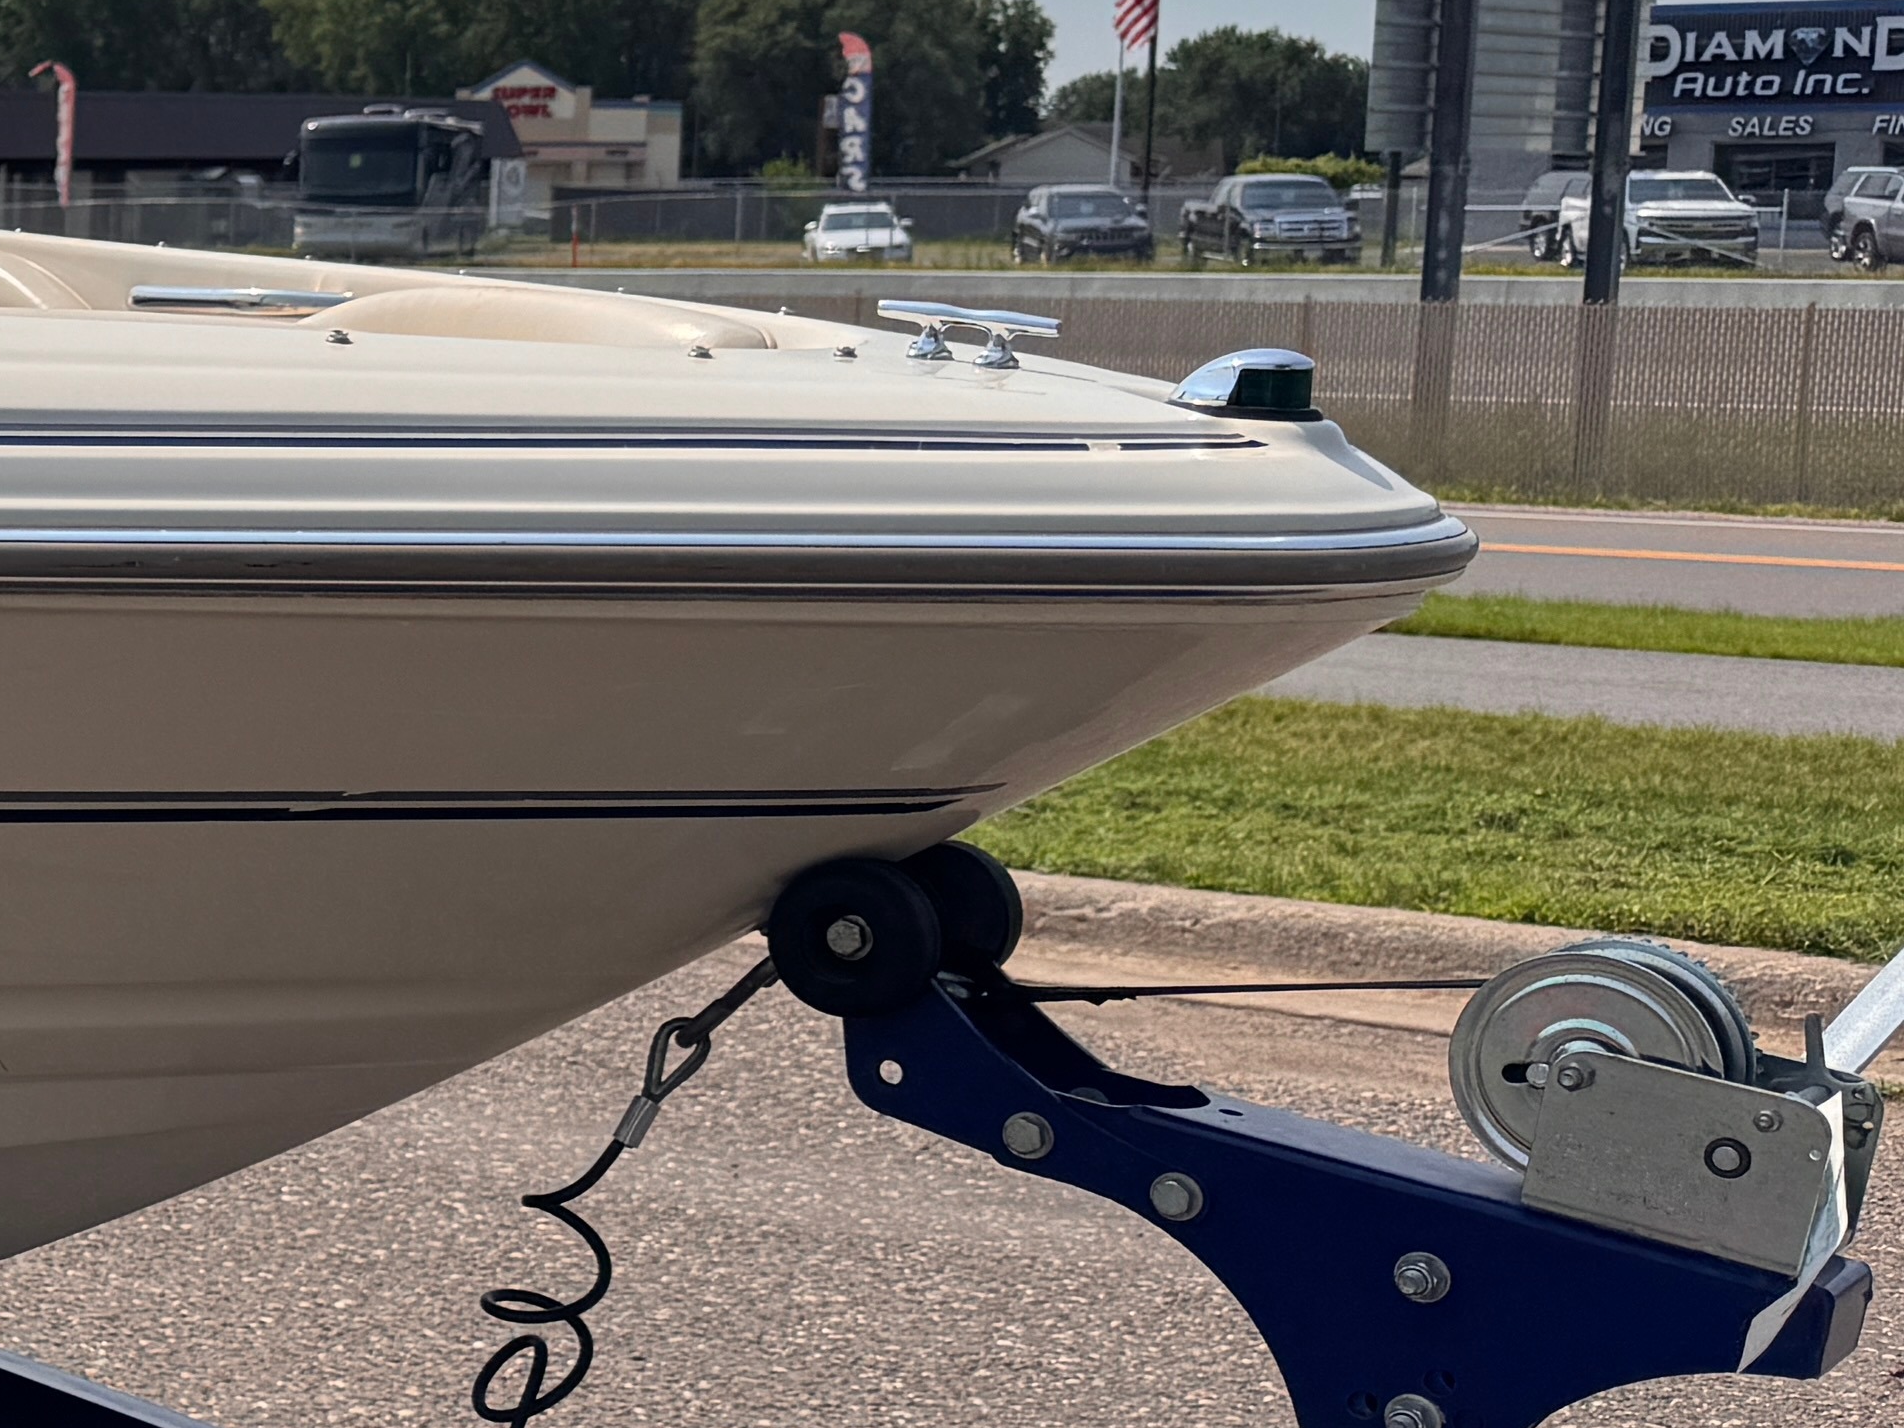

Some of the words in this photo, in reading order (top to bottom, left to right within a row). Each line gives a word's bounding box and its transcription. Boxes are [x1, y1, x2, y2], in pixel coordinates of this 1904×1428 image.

[1673, 71, 1781, 98] Auto
[1792, 69, 1871, 96] Inc.
[506, 104, 553, 120] OWL
[1728, 115, 1814, 138] SALES
